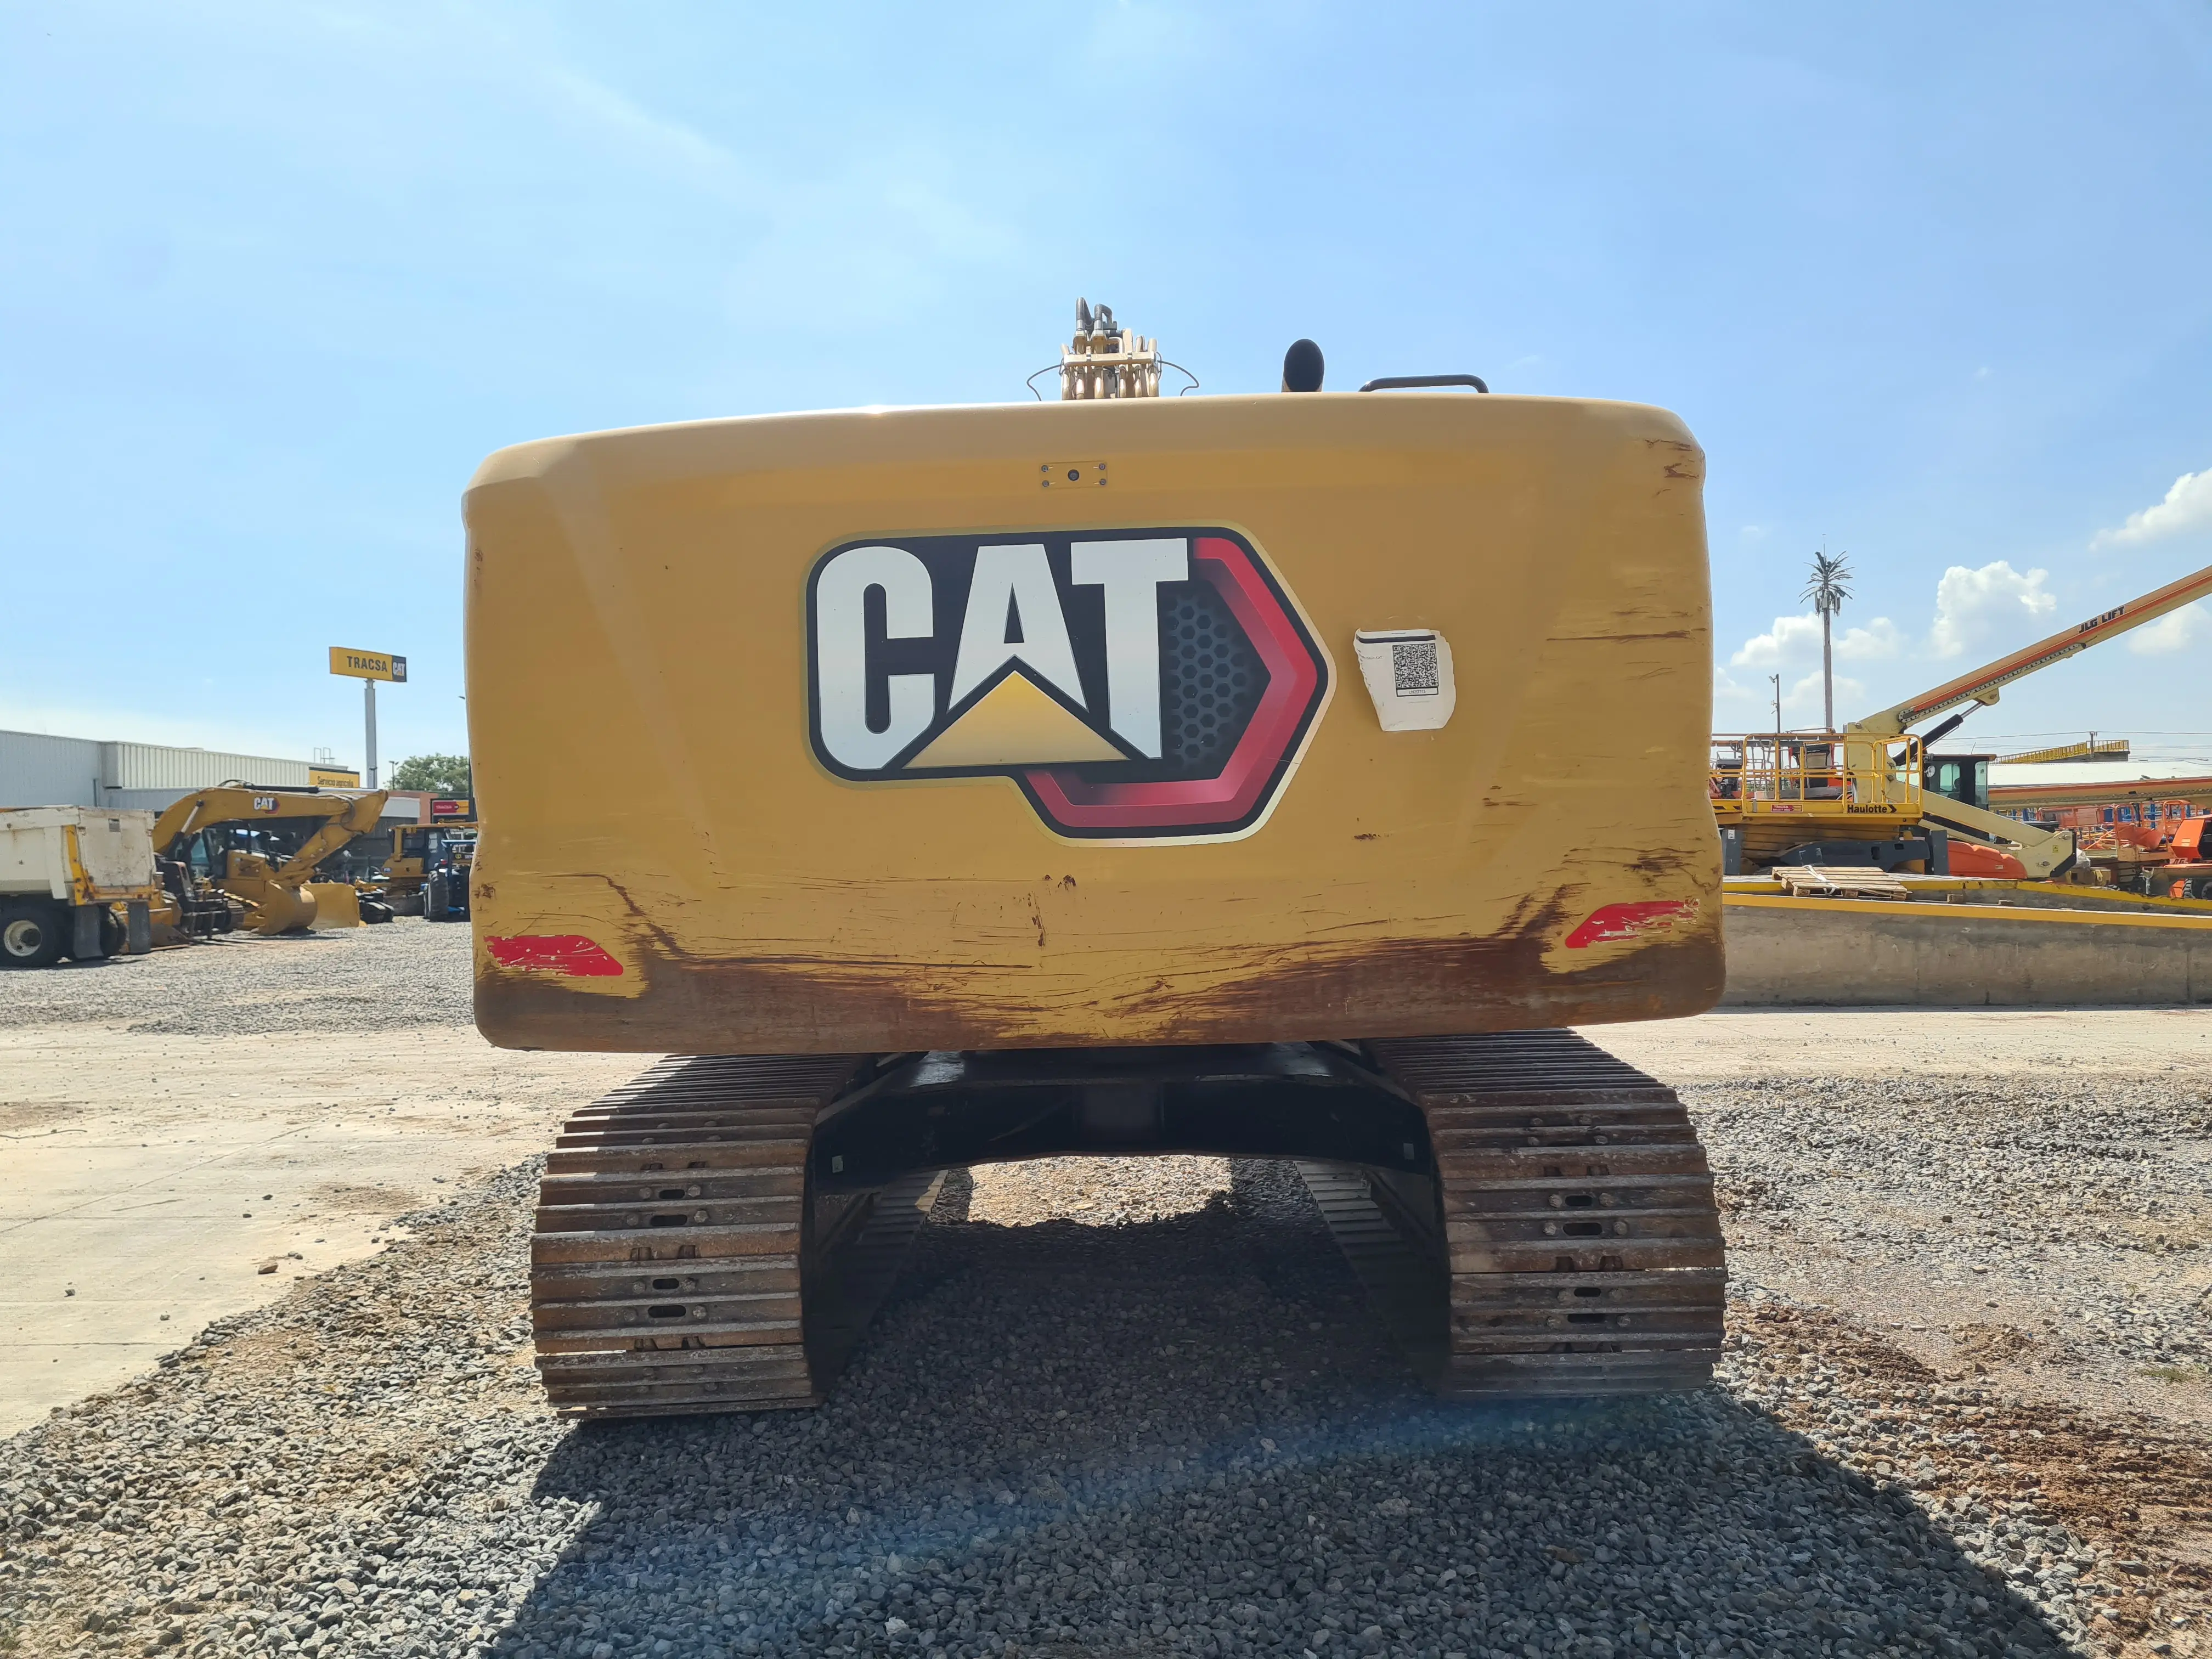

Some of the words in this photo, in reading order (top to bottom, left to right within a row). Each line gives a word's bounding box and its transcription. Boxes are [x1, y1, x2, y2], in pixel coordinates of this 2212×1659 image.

[2079, 617, 2098, 634] JLG
[2102, 606, 2125, 623] LIFT
[817, 538, 1188, 770] CAT
[346, 656, 388, 672] TRACSA
[392, 662, 405, 676] CAT
[253, 797, 275, 810] CAT
[1847, 804, 1887, 813] Haulotte
